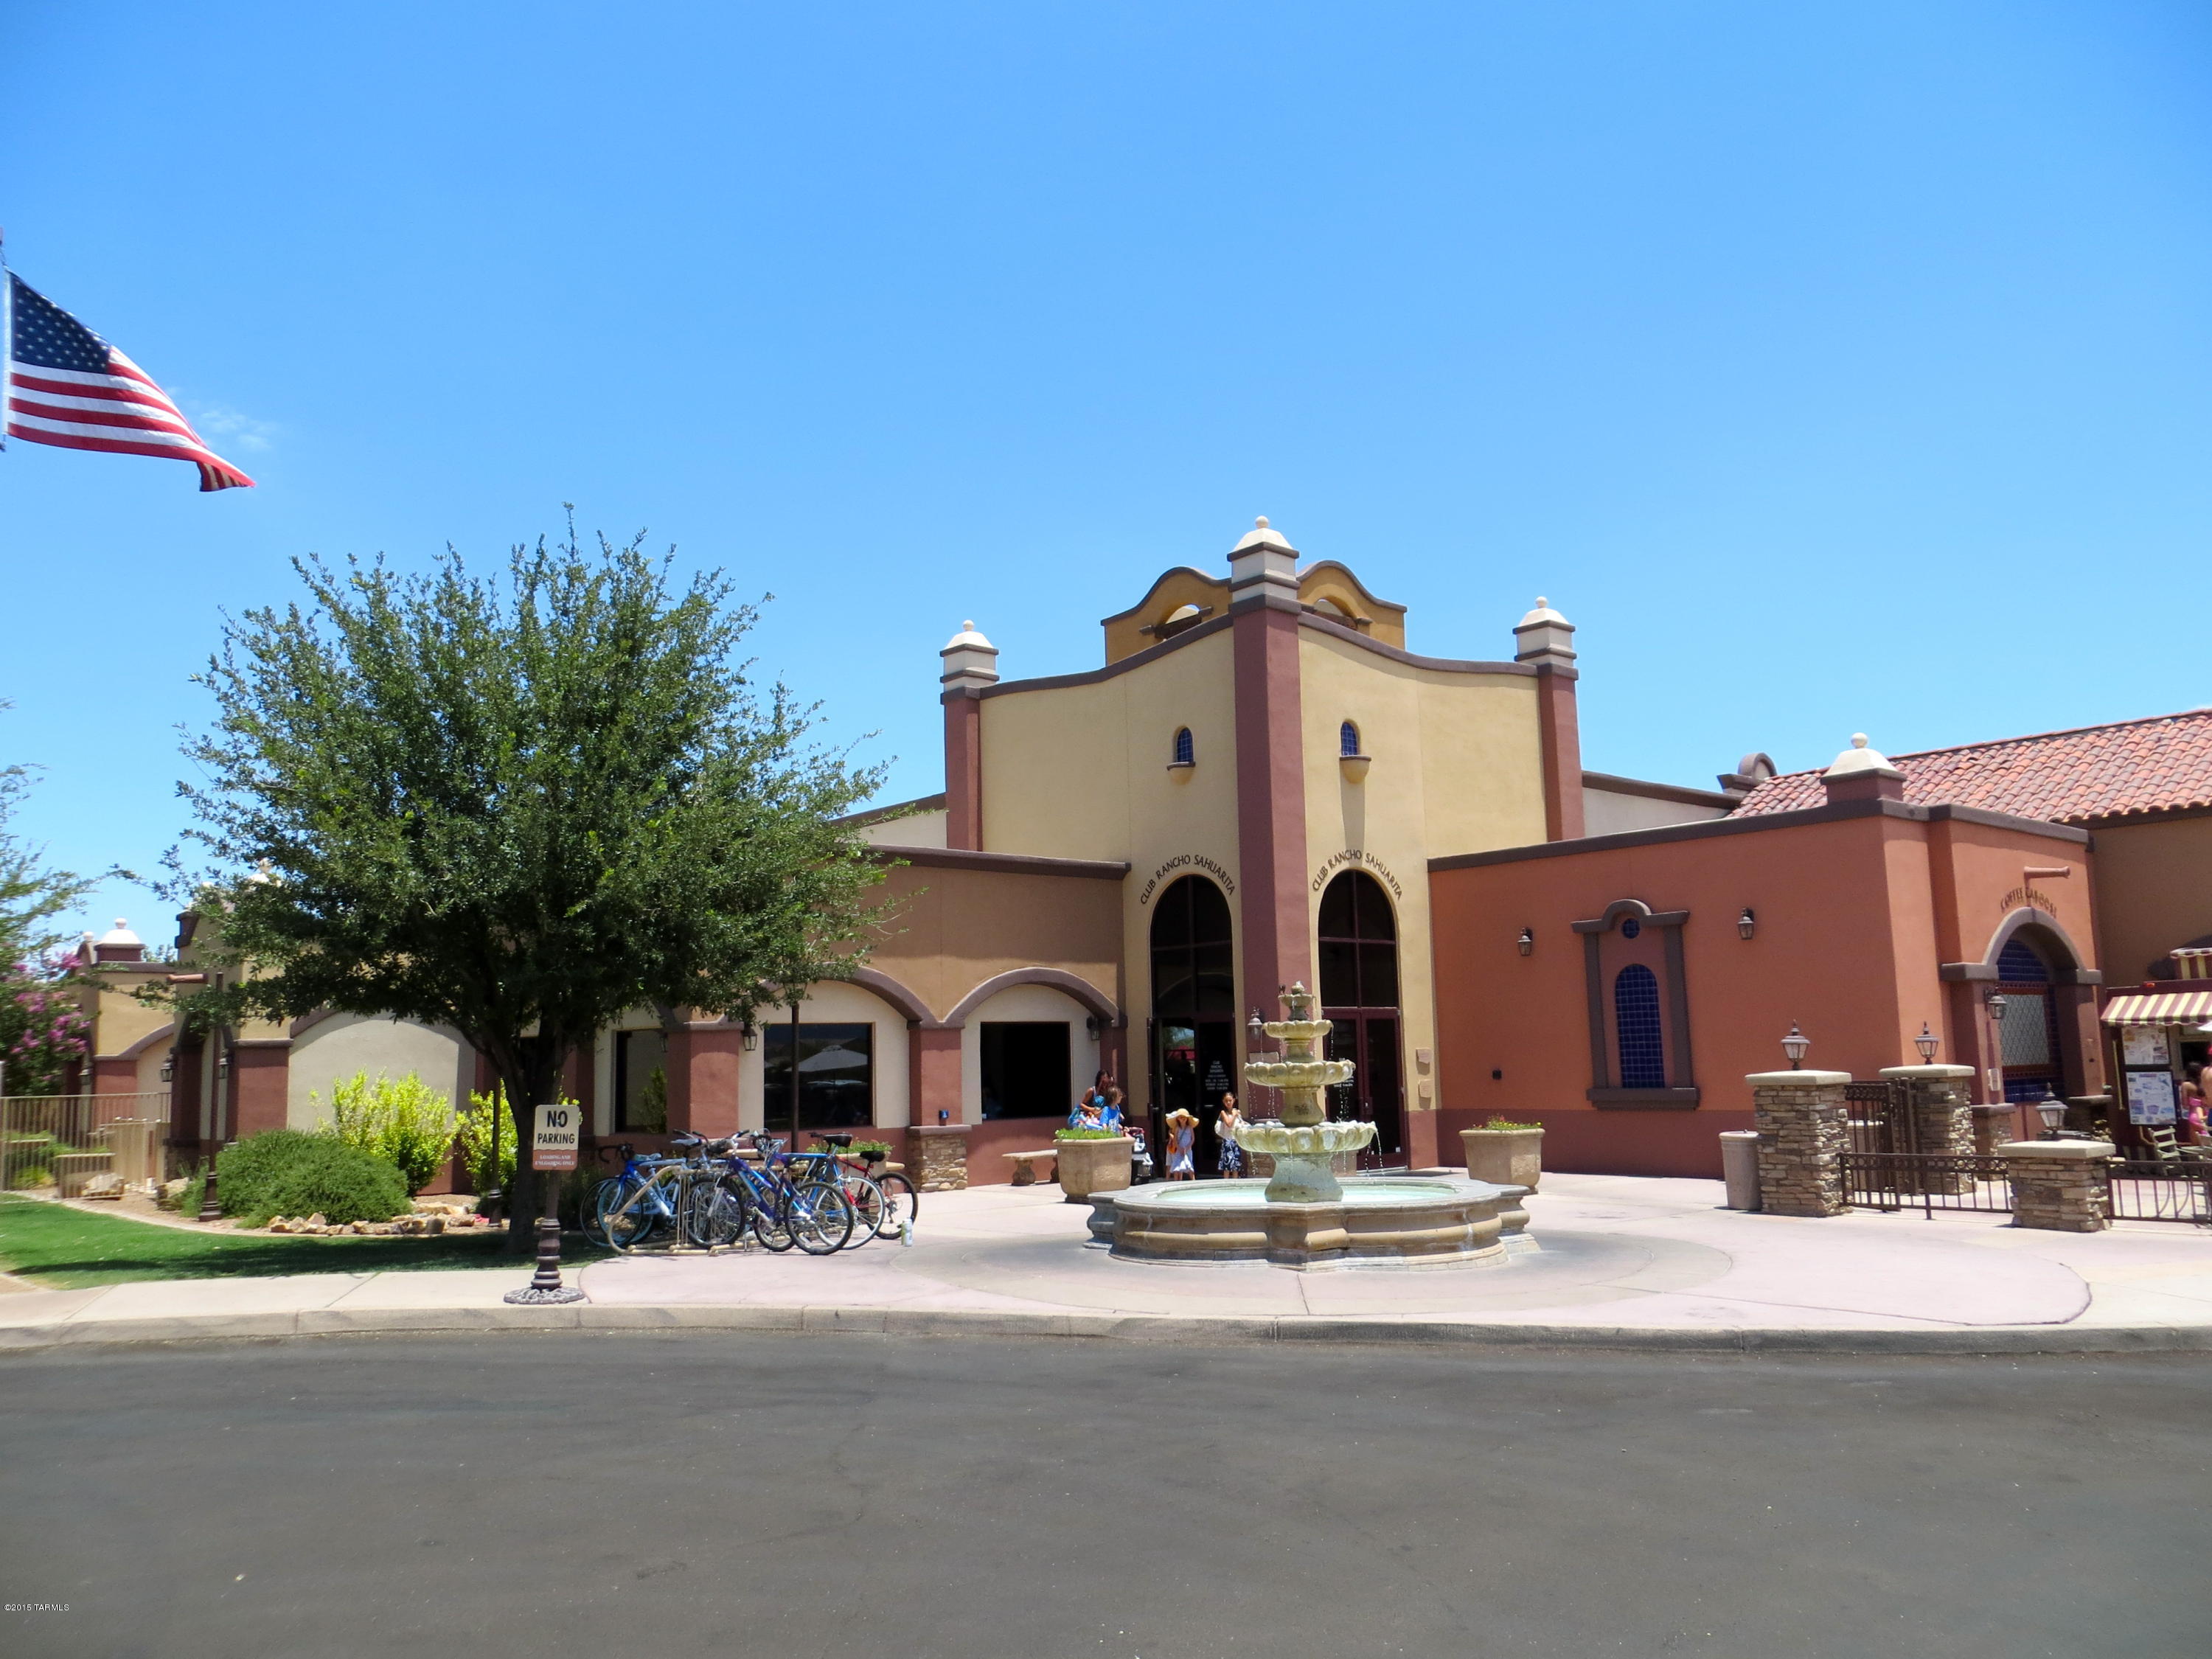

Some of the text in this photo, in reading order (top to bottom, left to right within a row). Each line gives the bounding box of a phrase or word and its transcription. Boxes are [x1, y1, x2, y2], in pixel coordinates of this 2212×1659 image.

[1140, 855, 1235, 905] CLUB RANCHO SAHUARITA
[1312, 849, 1402, 900] CLUB RANCHO SAHUARITA
[547, 1110, 568, 1127] NO
[538, 1133, 575, 1144] PARKING
